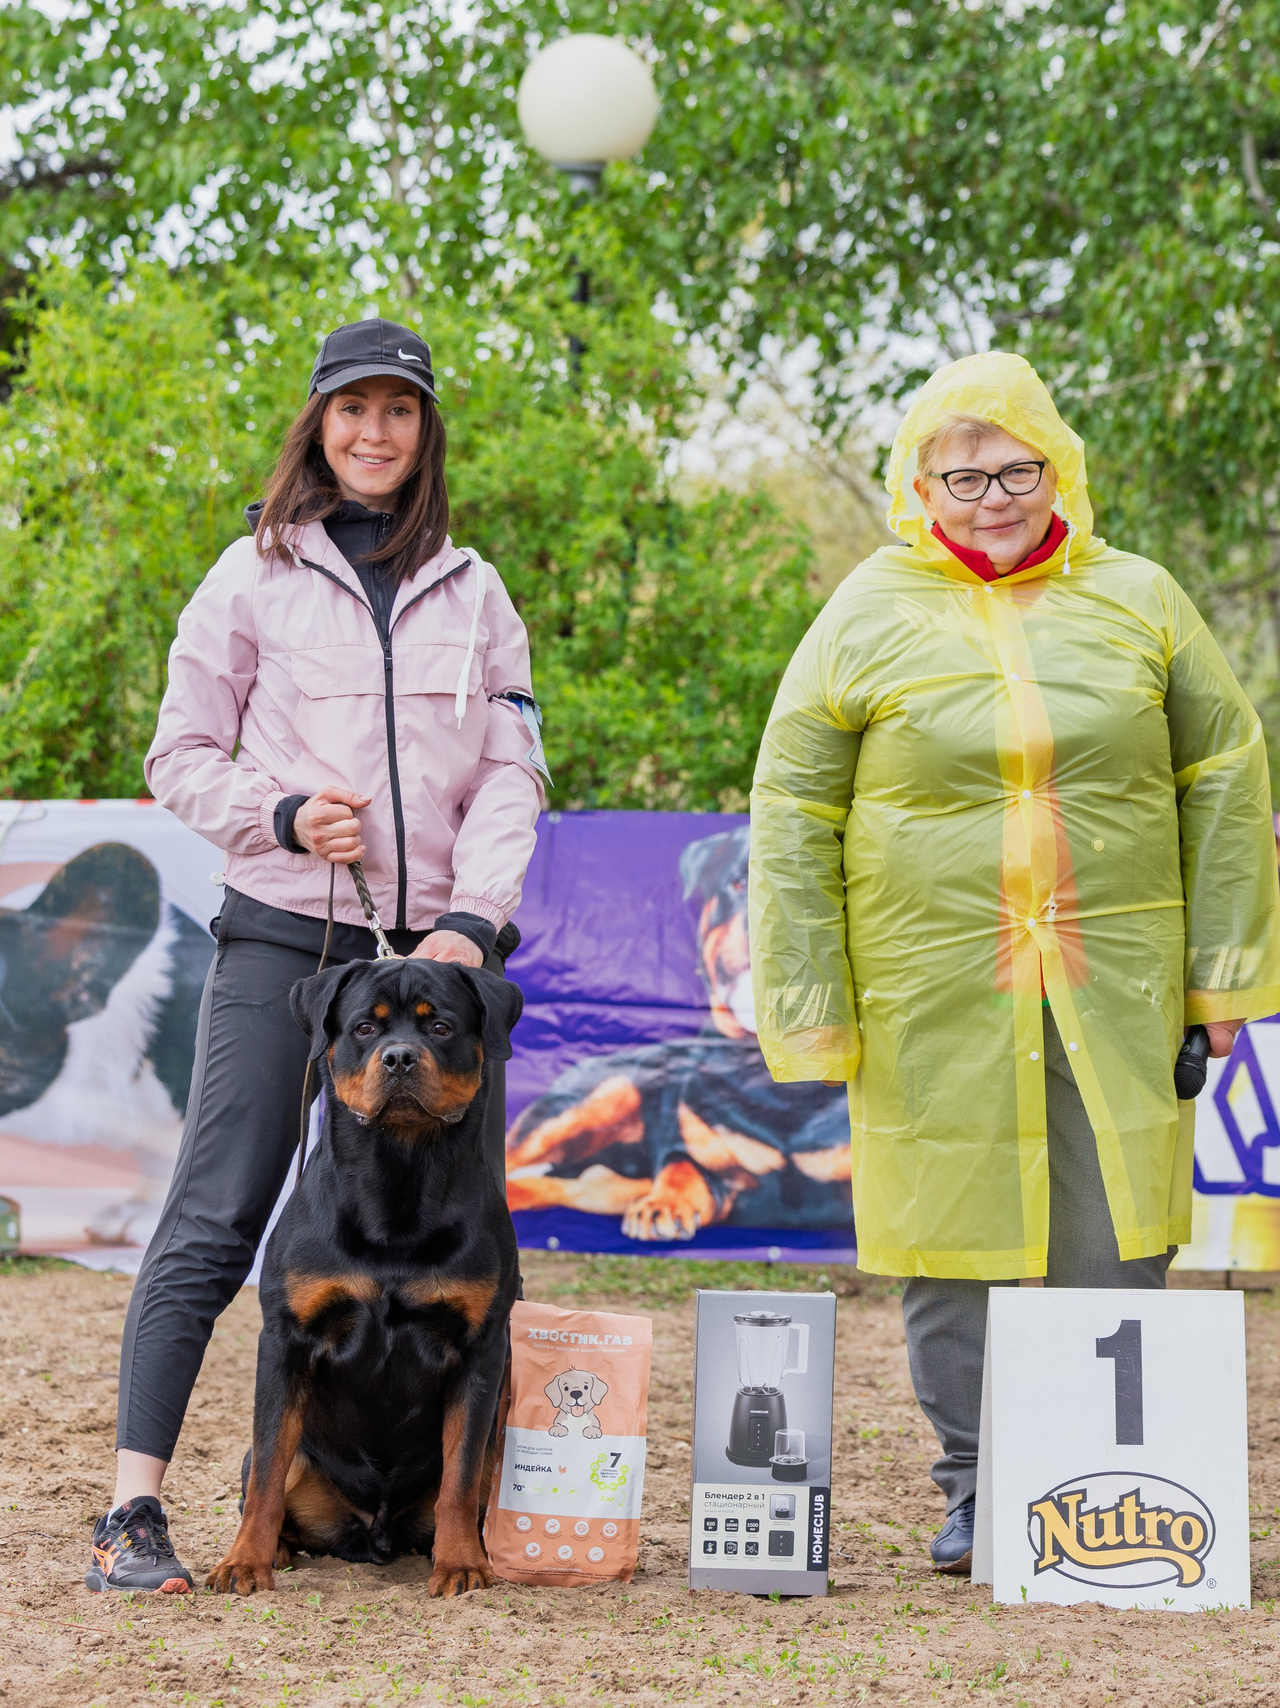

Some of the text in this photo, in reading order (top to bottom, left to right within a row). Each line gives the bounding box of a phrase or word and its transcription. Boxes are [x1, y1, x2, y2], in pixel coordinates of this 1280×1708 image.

[527, 1328, 633, 1346] ХВОСТИК.ГАВ
[1095, 1319, 1144, 1446] 1
[514, 1463, 552, 1473] ИНДЕЙКА
[610, 1452, 622, 1468] 7
[704, 1492, 745, 1501] Блендер
[704, 1501, 765, 1509] стационарный
[812, 1494, 825, 1564] HOMECLUB
[1029, 1489, 1206, 1586] Nutro
